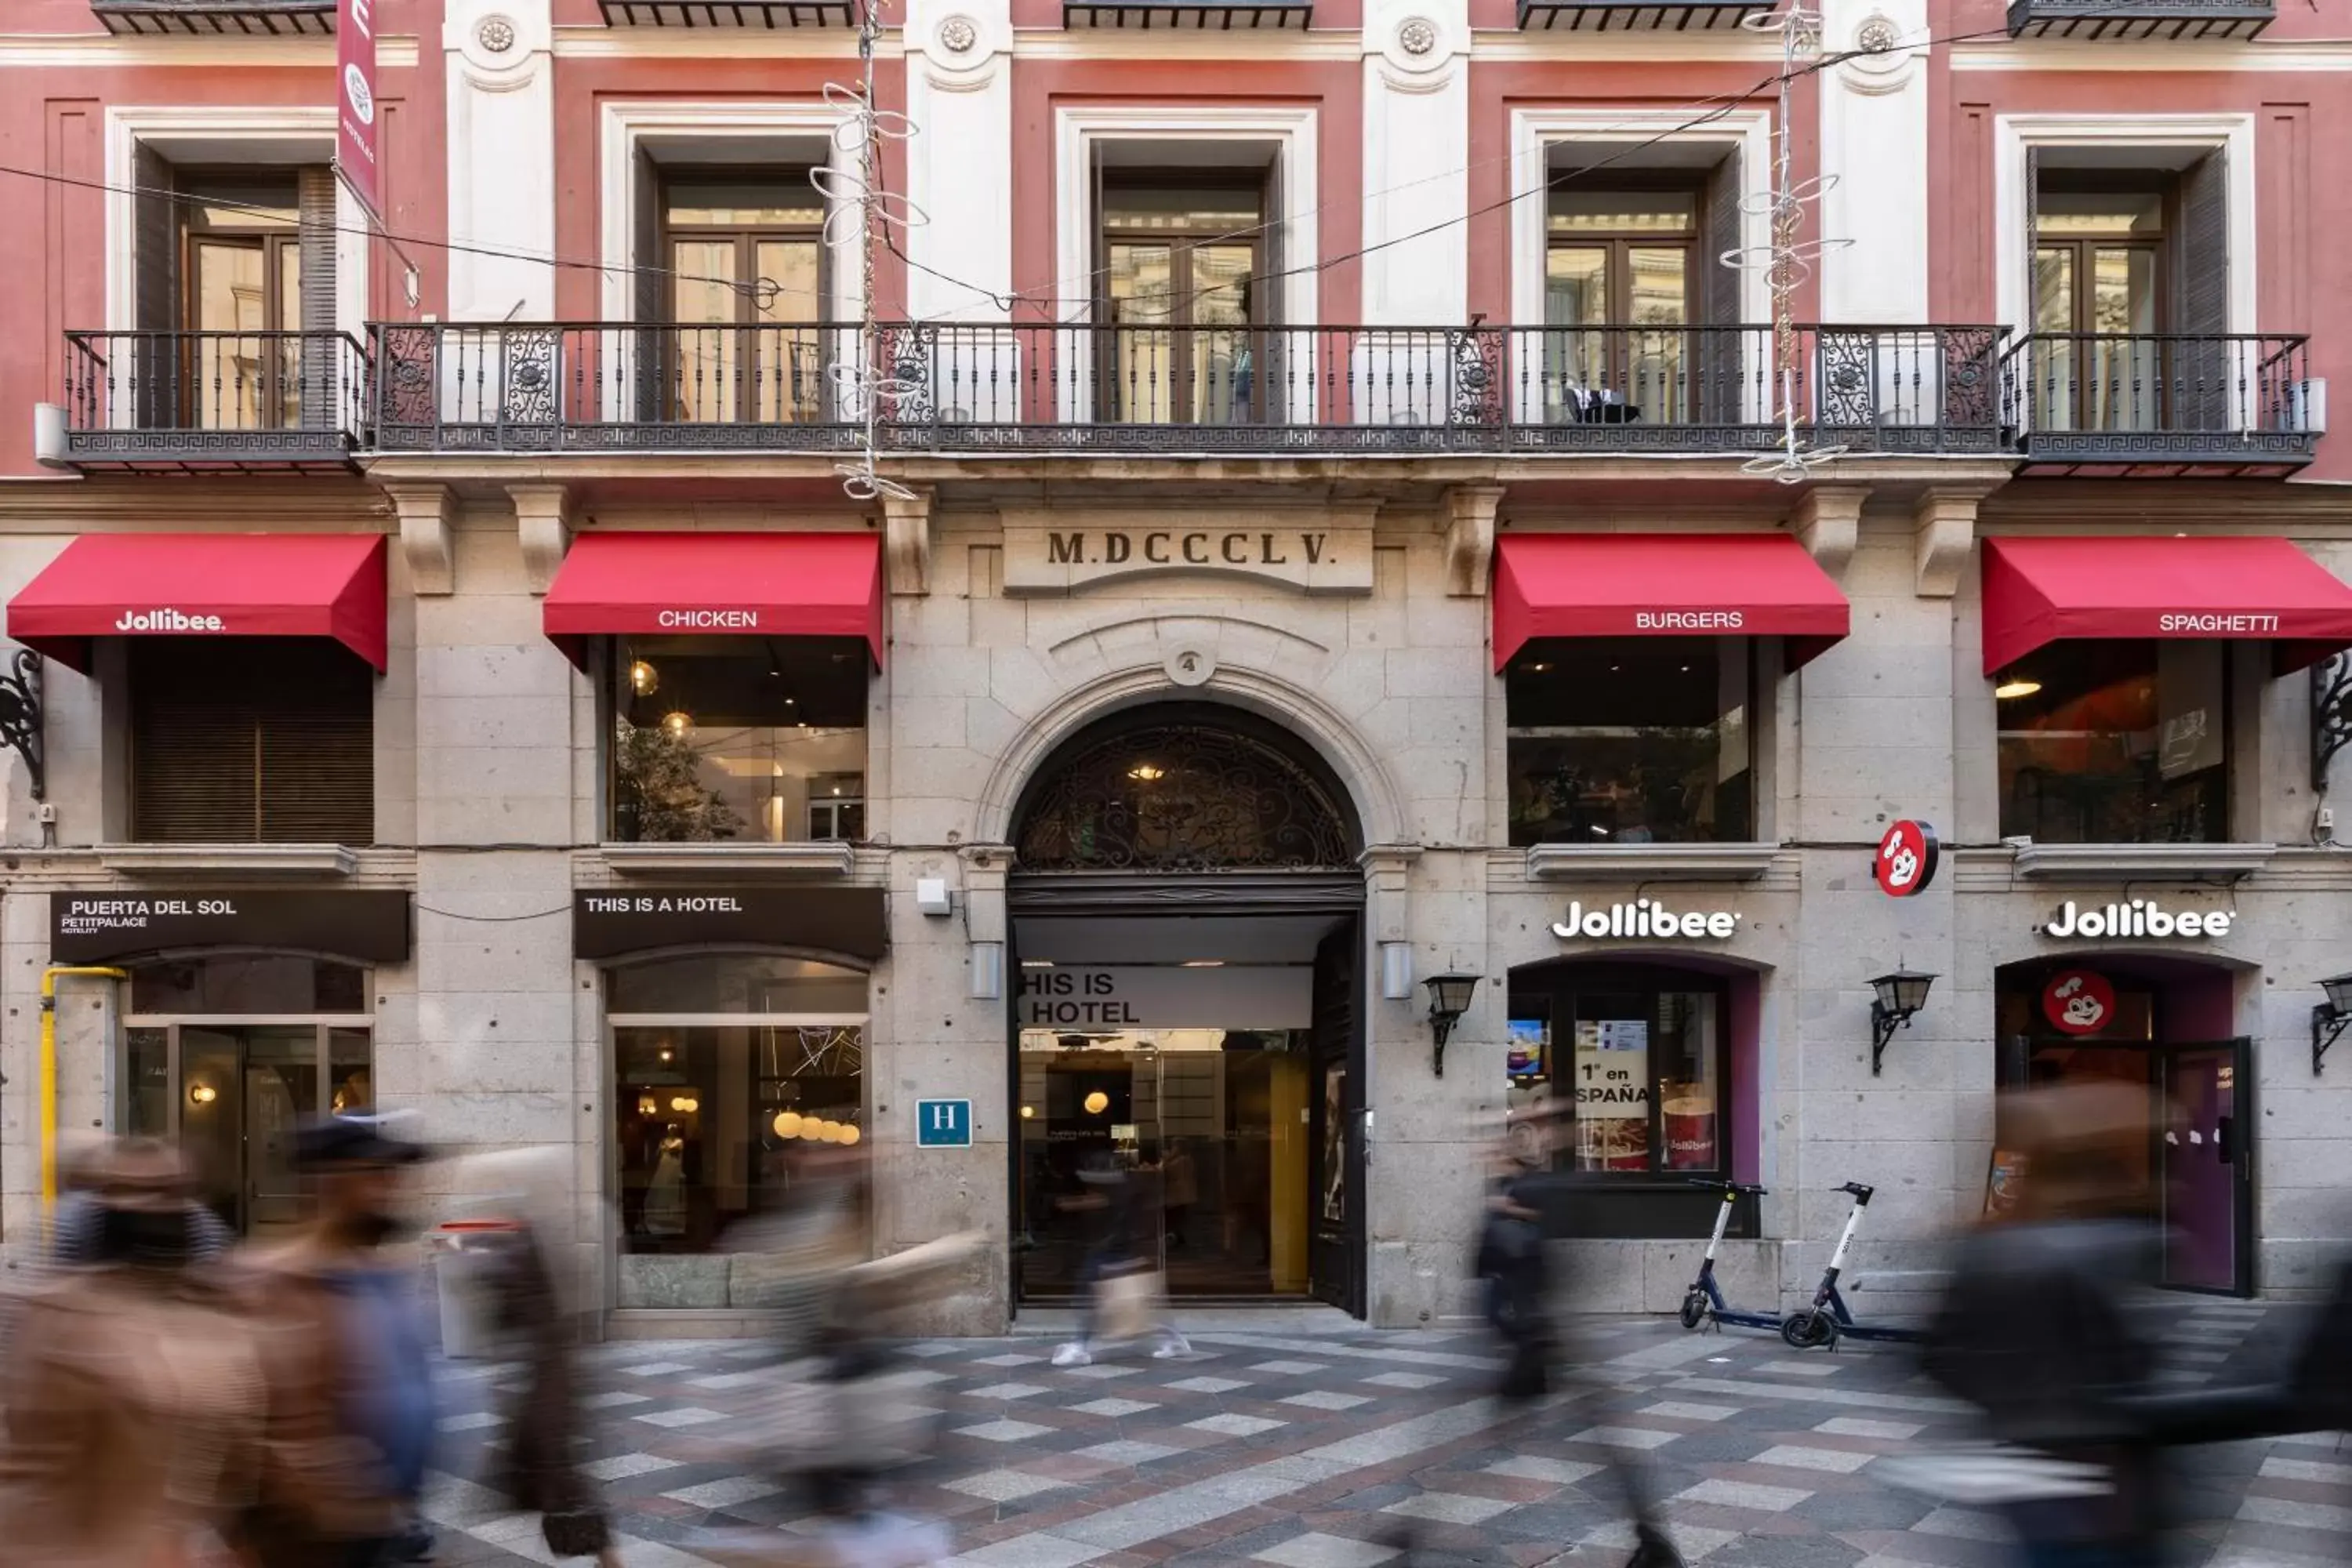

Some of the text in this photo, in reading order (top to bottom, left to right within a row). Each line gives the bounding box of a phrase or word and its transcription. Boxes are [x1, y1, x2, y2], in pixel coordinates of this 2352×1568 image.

[659, 610, 757, 627] CHICKEN
[1636, 611, 1743, 629] BURGERS
[2160, 614, 2278, 632] SPAGHETTI
[1182, 658, 1196, 672] 4
[71, 900, 237, 916] PUERTA DEL SOL
[585, 897, 742, 913] THIS IS A HOTEL
[1022, 973, 1114, 996] HIS IS
[1033, 1000, 1141, 1024] HOTEL
[1606, 1069, 1629, 1081] en
[1576, 1083, 1650, 1104] SPAÑA
[931, 1104, 956, 1130] H
